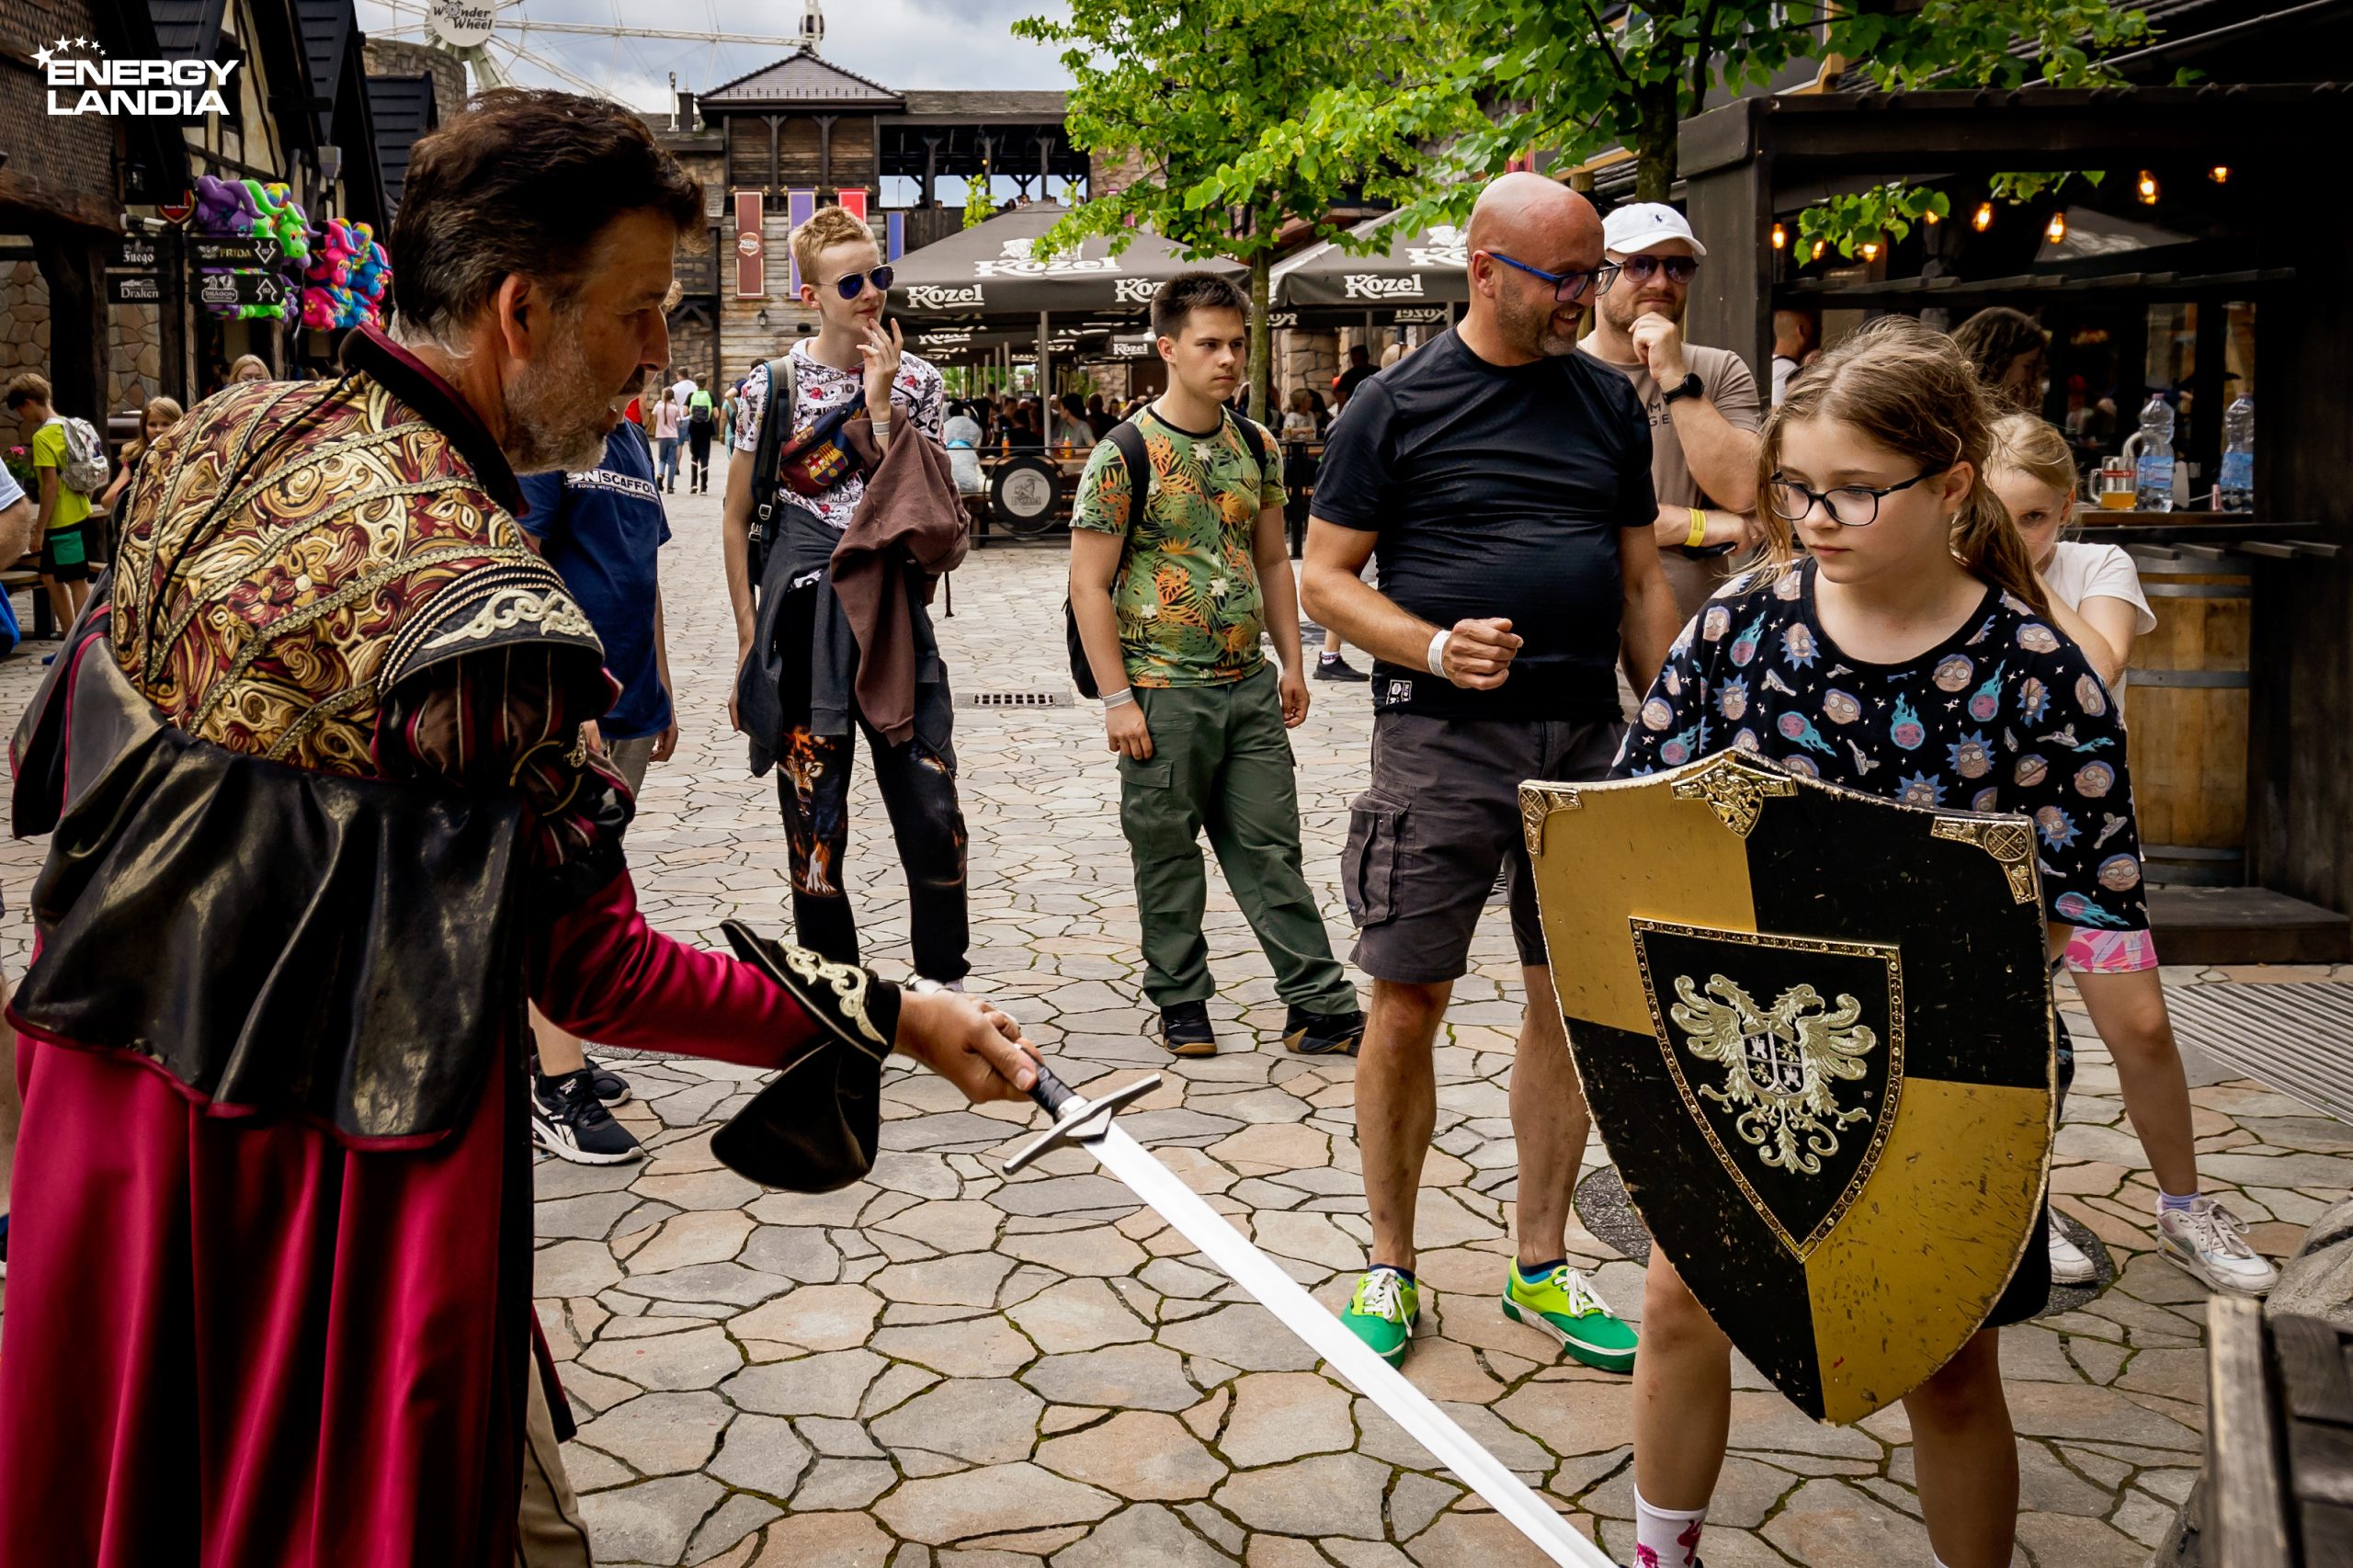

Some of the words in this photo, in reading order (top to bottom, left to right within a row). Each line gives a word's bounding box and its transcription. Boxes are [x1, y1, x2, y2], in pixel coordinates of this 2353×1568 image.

[444, 17, 493, 29] Wheel
[123, 251, 154, 265] Fuego
[974, 256, 1122, 277] Kozel
[120, 287, 159, 299] Draken
[1115, 278, 1166, 303] Koz
[1344, 273, 1424, 299] Kozel
[906, 283, 984, 310] Kozel
[1113, 343, 1149, 356] Kozel
